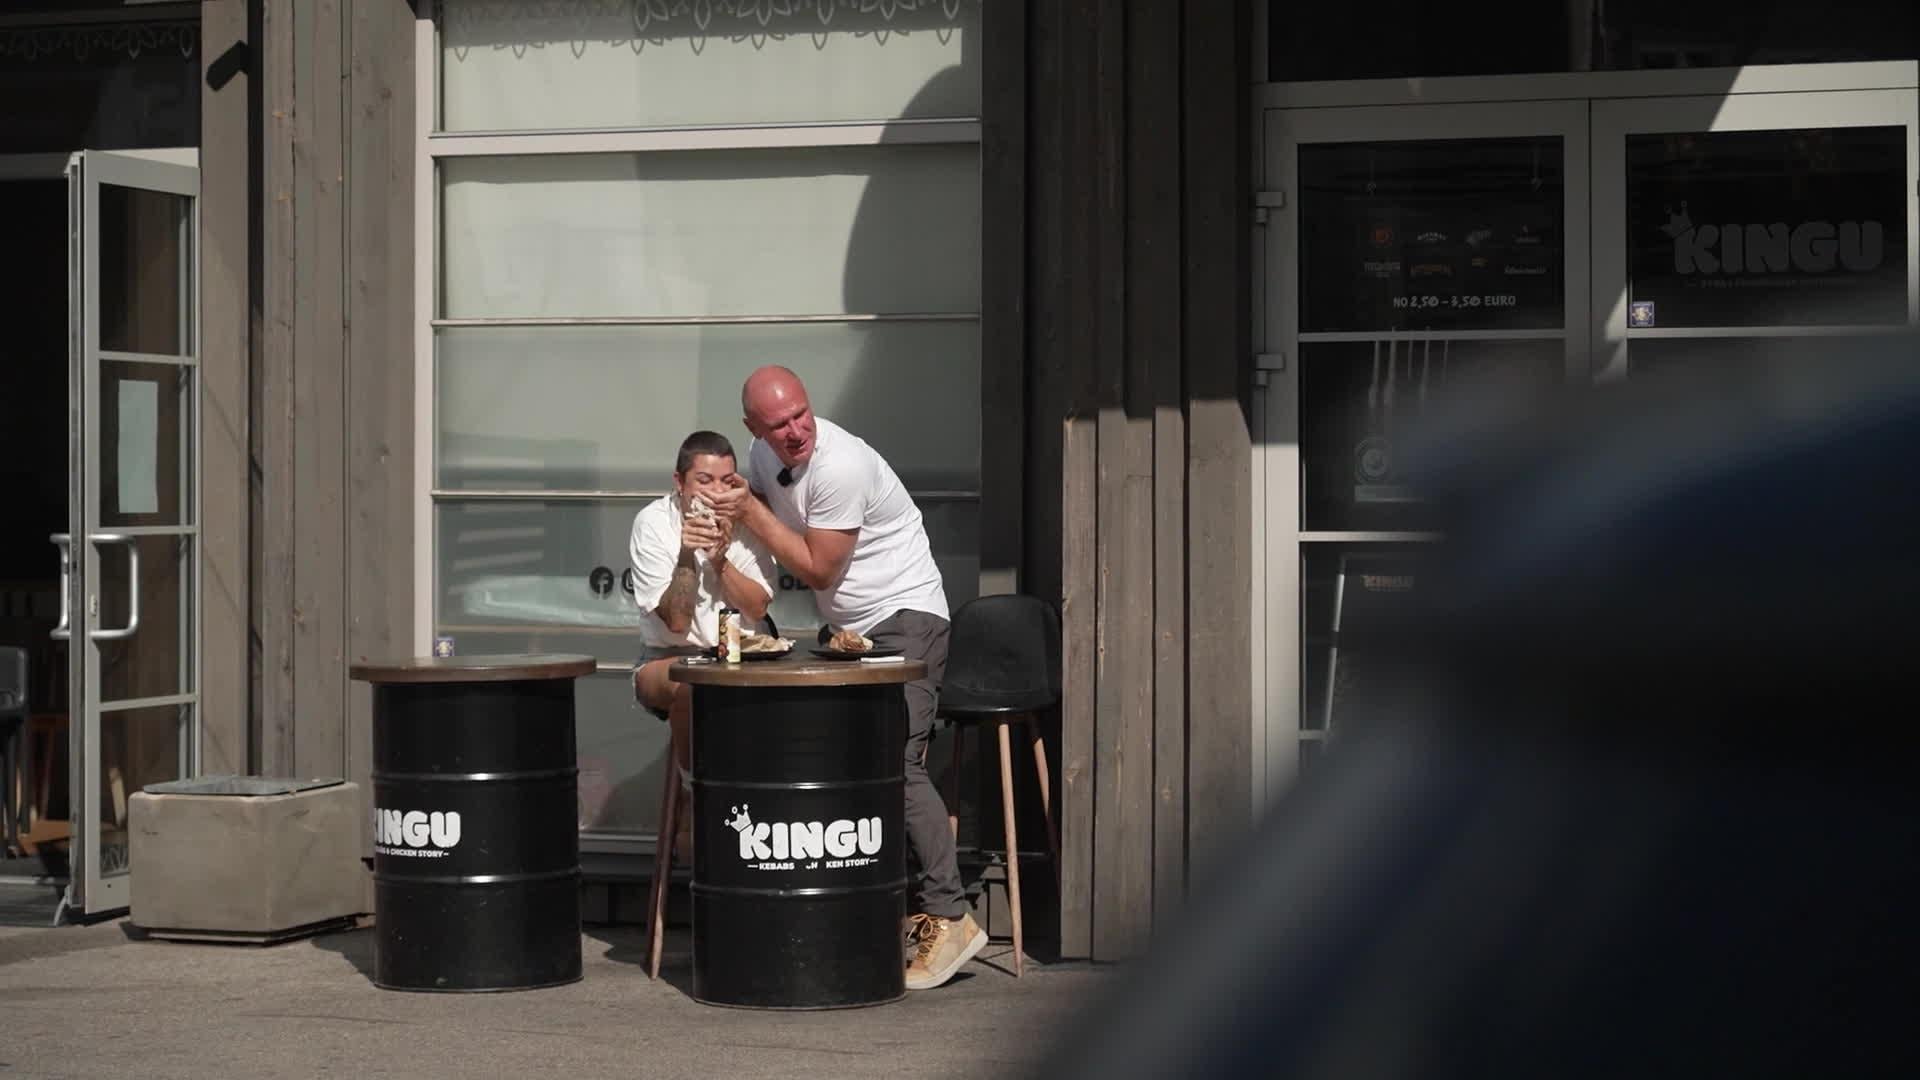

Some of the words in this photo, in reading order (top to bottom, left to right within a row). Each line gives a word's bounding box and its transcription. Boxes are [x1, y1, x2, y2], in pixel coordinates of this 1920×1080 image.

[1674, 220, 1882, 273] KINGU
[1393, 296, 1408, 308] NO
[1410, 296, 1440, 309] 2,50
[1485, 296, 1517, 307] EURO
[375, 808, 461, 848] INGU
[739, 816, 882, 860] KINGU
[390, 848, 417, 857] CHICKEN
[418, 850, 444, 858] STORY
[759, 862, 795, 871] KEBABS
[844, 858, 871, 868] STORY
